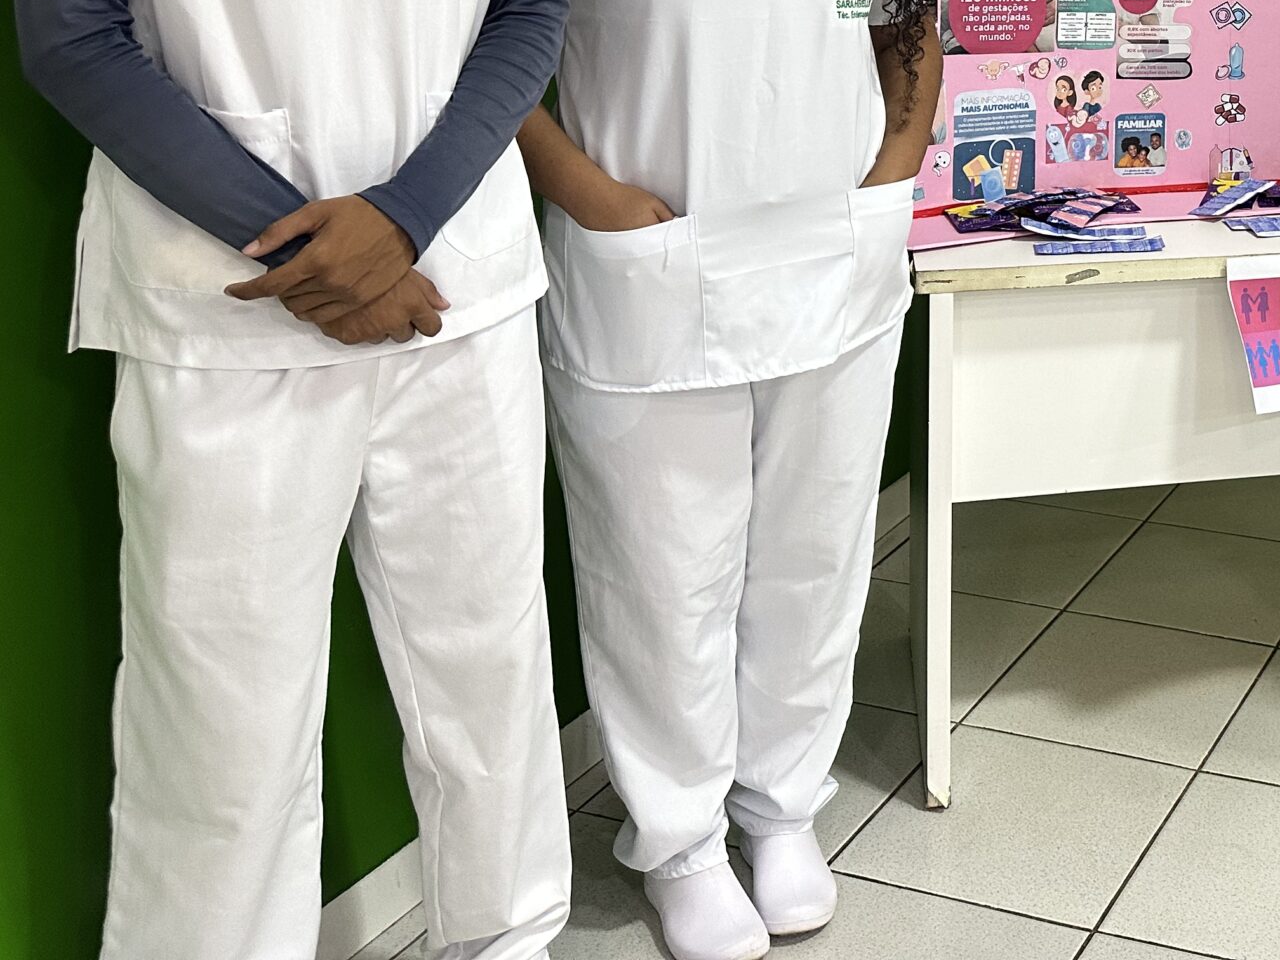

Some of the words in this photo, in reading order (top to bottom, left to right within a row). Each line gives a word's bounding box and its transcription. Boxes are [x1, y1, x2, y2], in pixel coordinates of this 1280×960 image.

[968, 4, 980, 12] de
[982, 3, 1028, 14] gestações
[962, 13, 980, 22] não
[981, 13, 1033, 23] planejadas,
[973, 23, 995, 31] cada
[997, 24, 1016, 32] ano,
[961, 97, 979, 105] MAIS
[980, 92, 1030, 104] INFORMAÇÃO
[961, 105, 981, 113] MAIS
[982, 102, 1029, 112] AUTONOMIA
[1117, 120, 1163, 128] FAMILIAR
